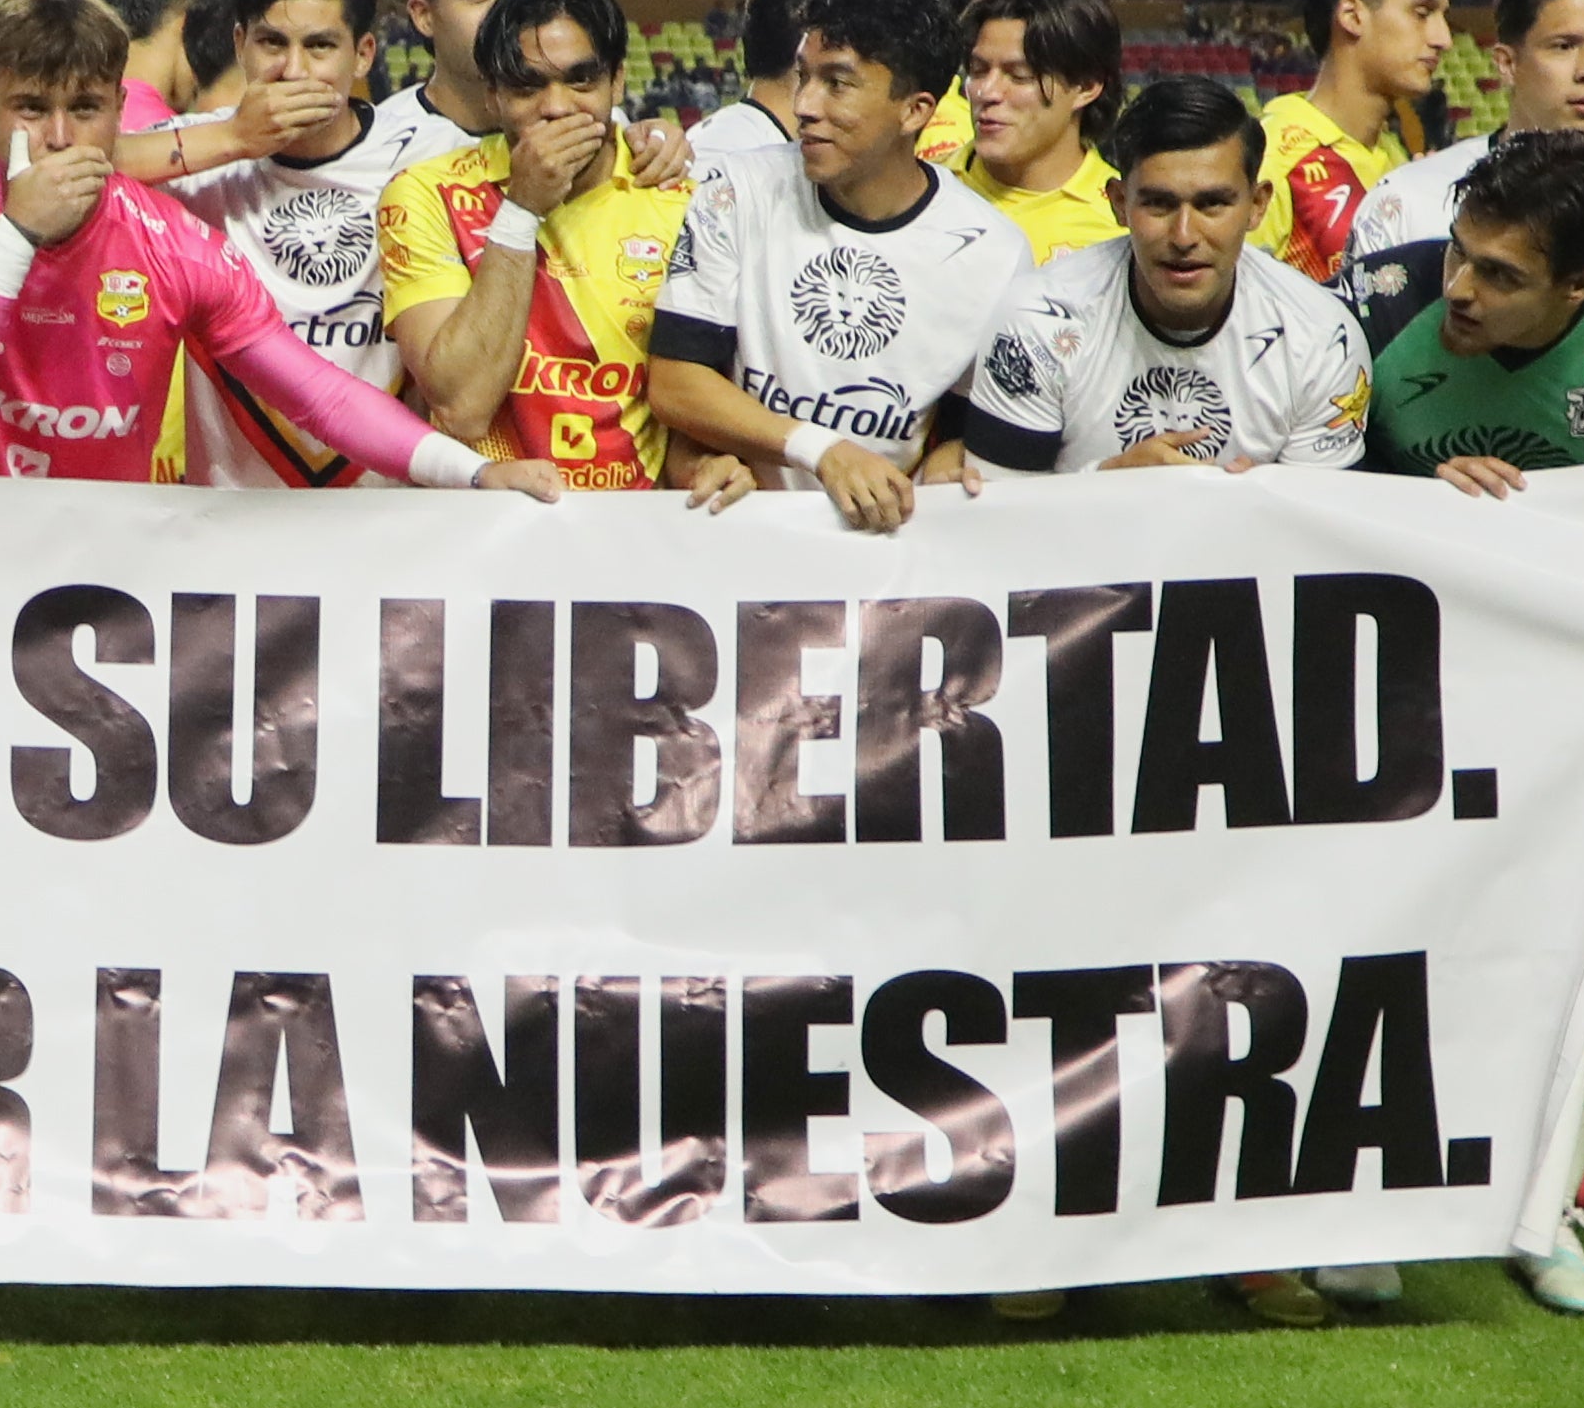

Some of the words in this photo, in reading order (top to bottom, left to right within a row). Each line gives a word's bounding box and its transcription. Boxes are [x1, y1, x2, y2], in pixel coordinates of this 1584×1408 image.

[516, 349, 648, 398] KRON
[1031, 343, 1058, 378] BBVA
[10, 582, 321, 846] SU
[376, 571, 1499, 848] LIBERTAD.
[90, 966, 366, 1223] LA
[411, 949, 1493, 1229] NUESTRA.
